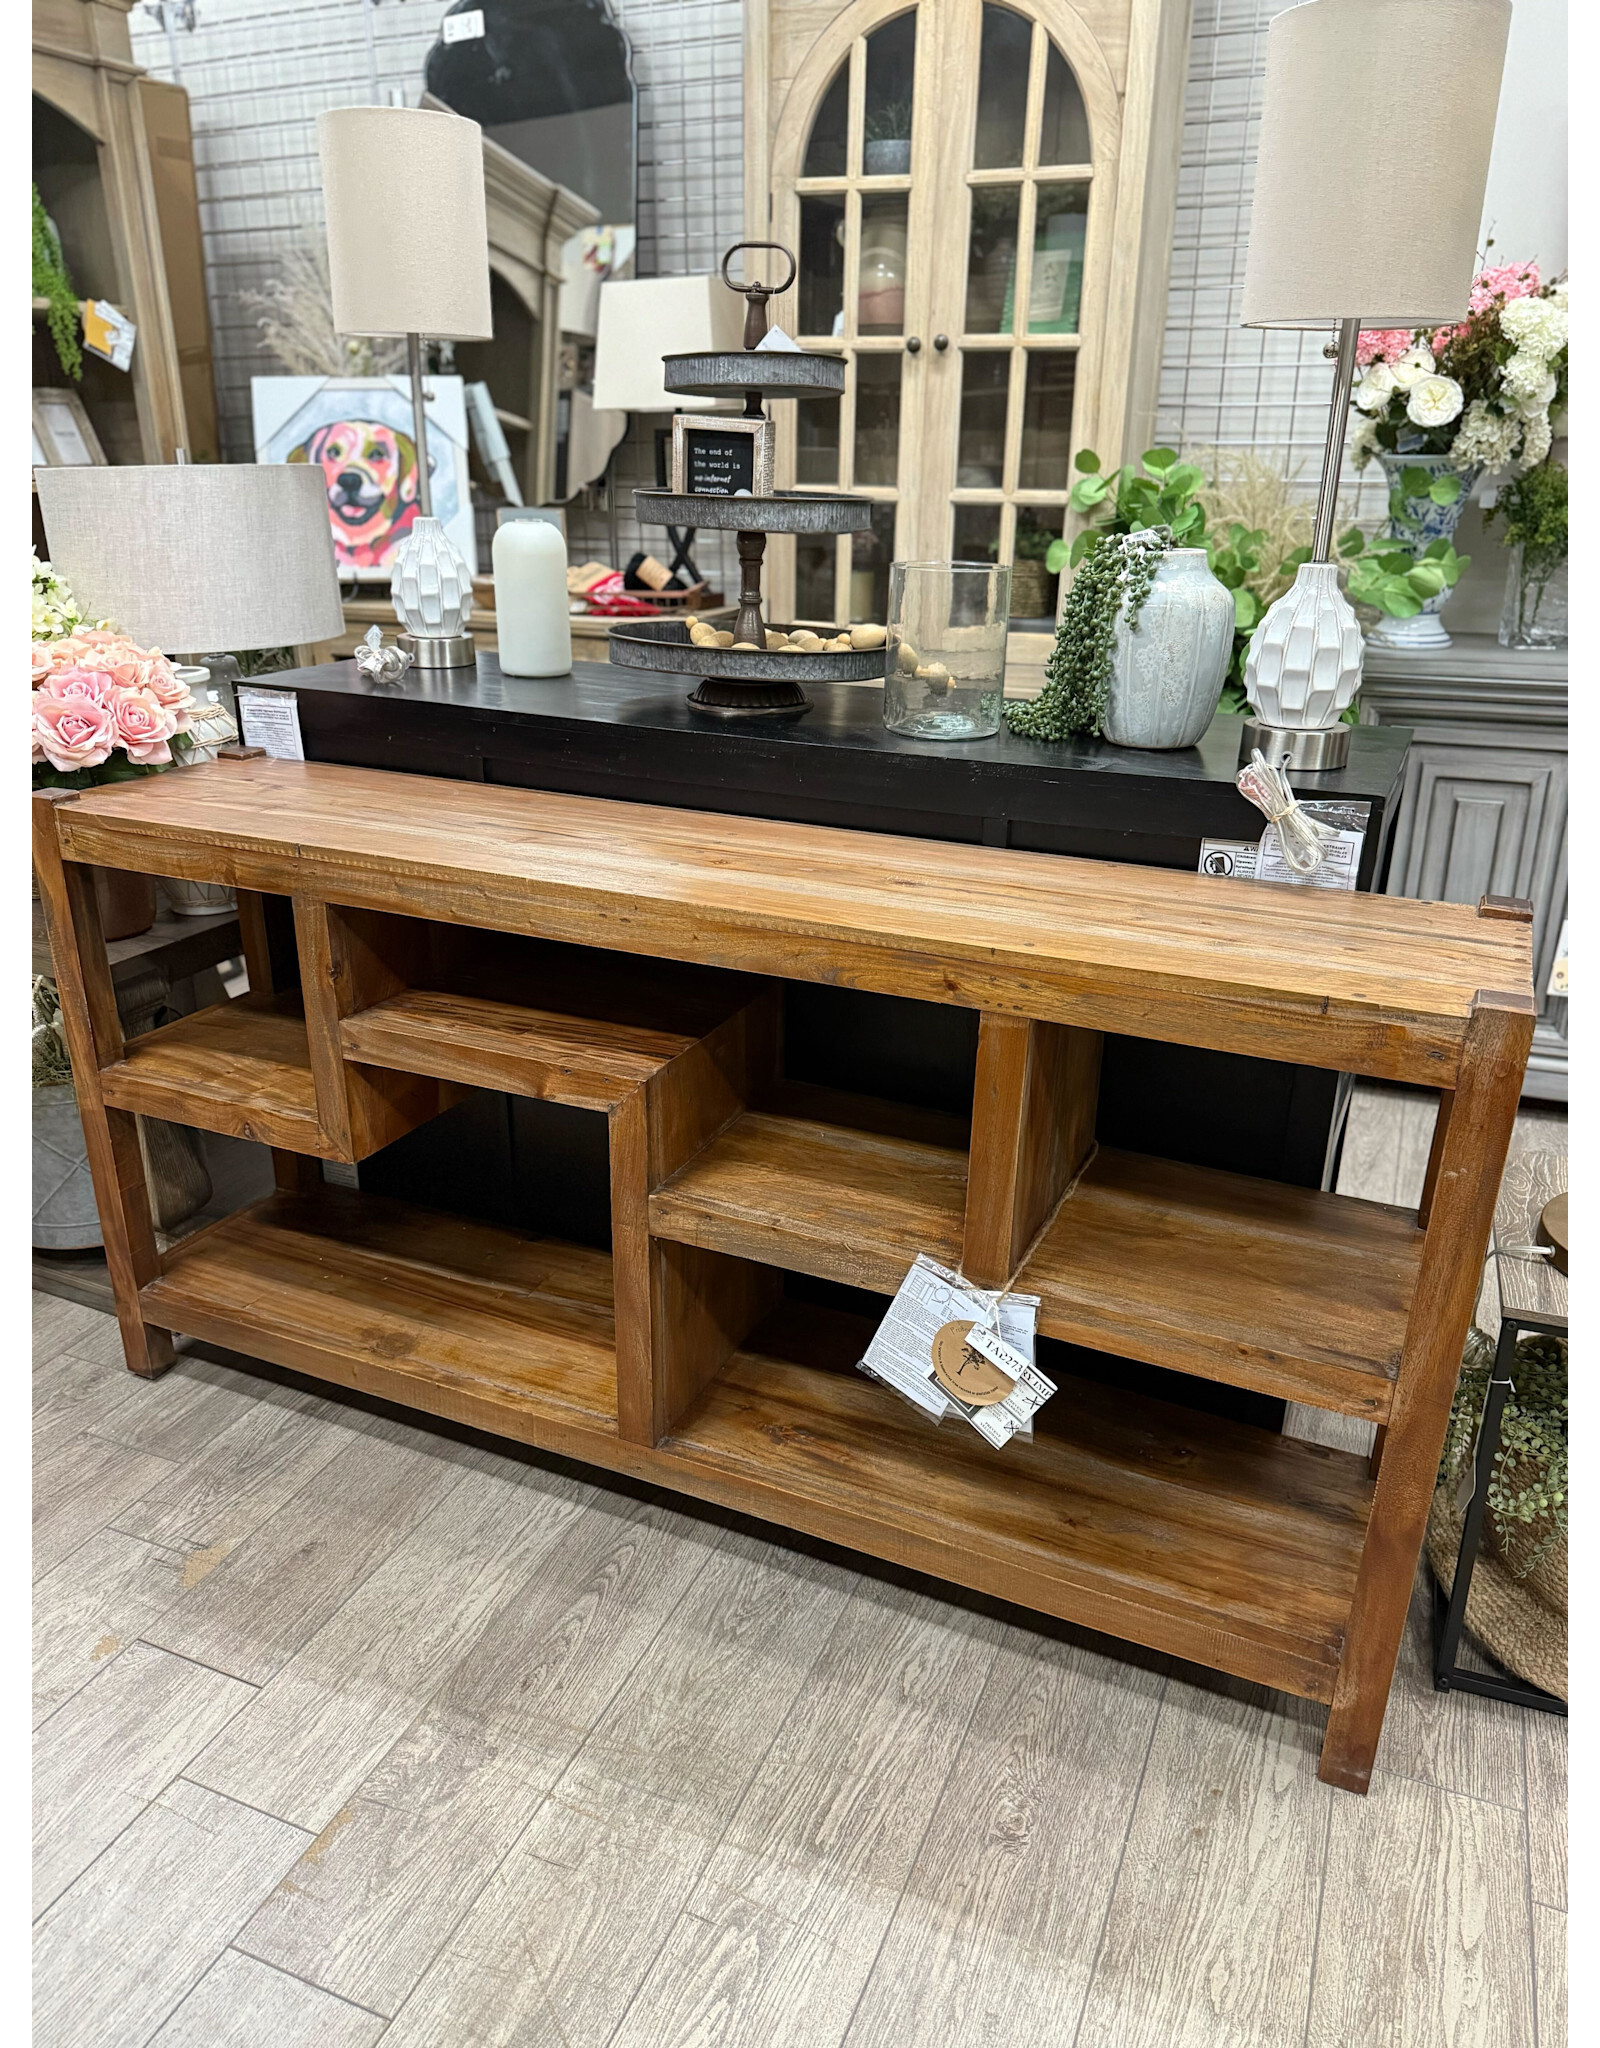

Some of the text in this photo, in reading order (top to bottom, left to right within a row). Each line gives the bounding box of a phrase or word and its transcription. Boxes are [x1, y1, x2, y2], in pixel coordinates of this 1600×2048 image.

[694, 447, 706, 455] The
[694, 460, 741, 470] the world is
